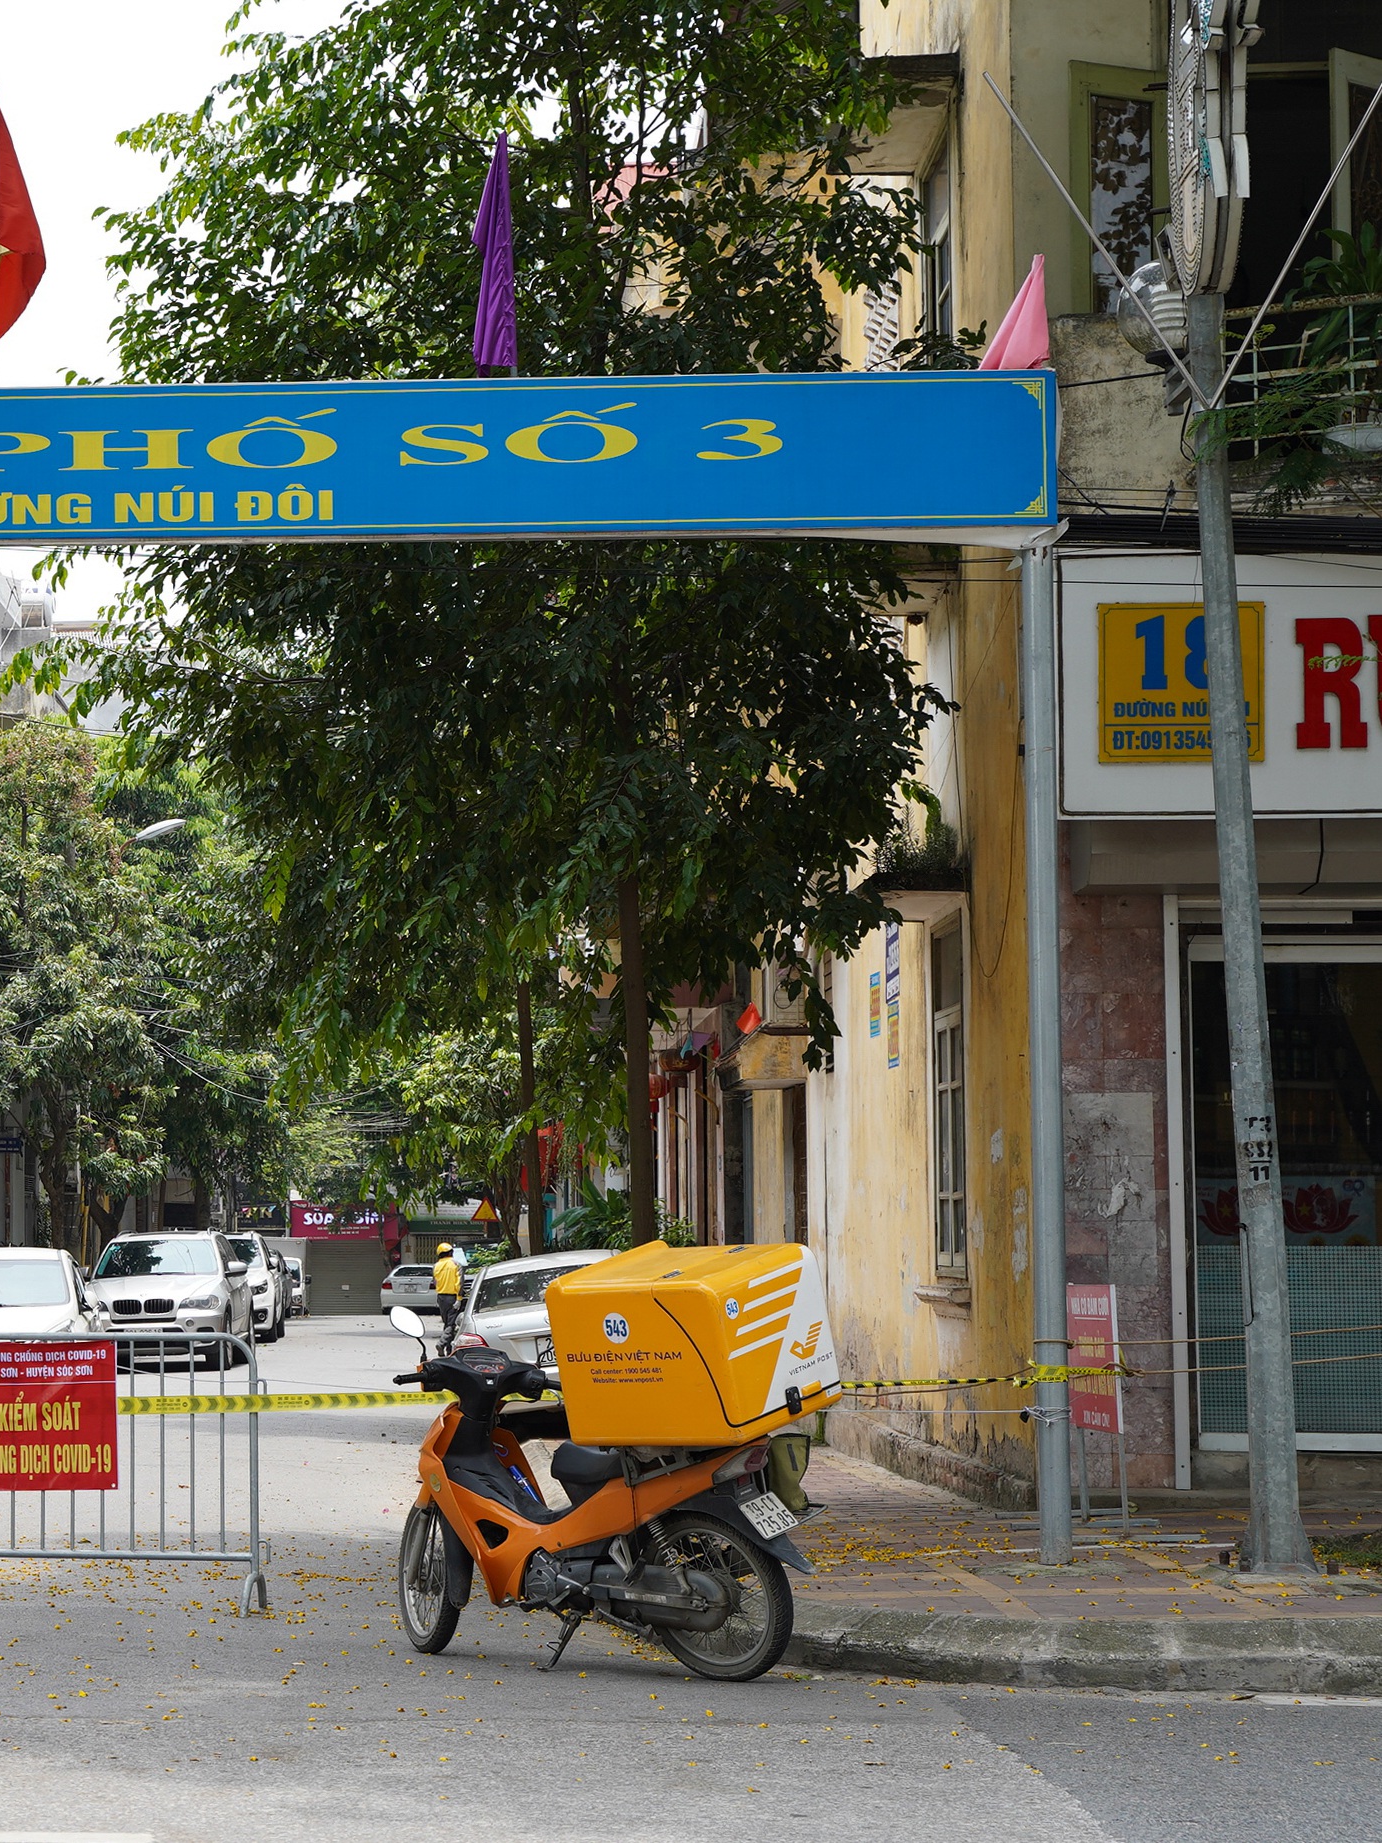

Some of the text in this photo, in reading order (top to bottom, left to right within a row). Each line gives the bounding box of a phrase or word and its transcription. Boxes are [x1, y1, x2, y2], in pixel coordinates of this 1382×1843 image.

[399, 402, 638, 466] SỐ
[695, 418, 784, 461] 3
[115, 484, 215, 523] NÚI
[235, 484, 334, 521] ĐÔI
[1114, 698, 1211, 717] ĐƯỜNG NÚ
[726, 1301, 739, 1316] 543
[605, 1319, 628, 1337] 543
[14, 1348, 43, 1362] CHỐNG
[45, 1351, 66, 1363] DỊCH
[67, 1349, 106, 1361] COVID-19
[567, 1349, 682, 1364] BƯU ĐIỆN VIỆT NAM
[789, 1351, 833, 1376] VIETNAM POST
[0, 1366, 18, 1377] SƠN
[26, 1366, 54, 1379] HUYỆN
[56, 1365, 74, 1377] SÓC
[75, 1365, 93, 1376] SƠN
[41, 1396, 81, 1431] SOÁT
[20, 1444, 50, 1480] DỊCH
[53, 1443, 112, 1474] COVID-19
